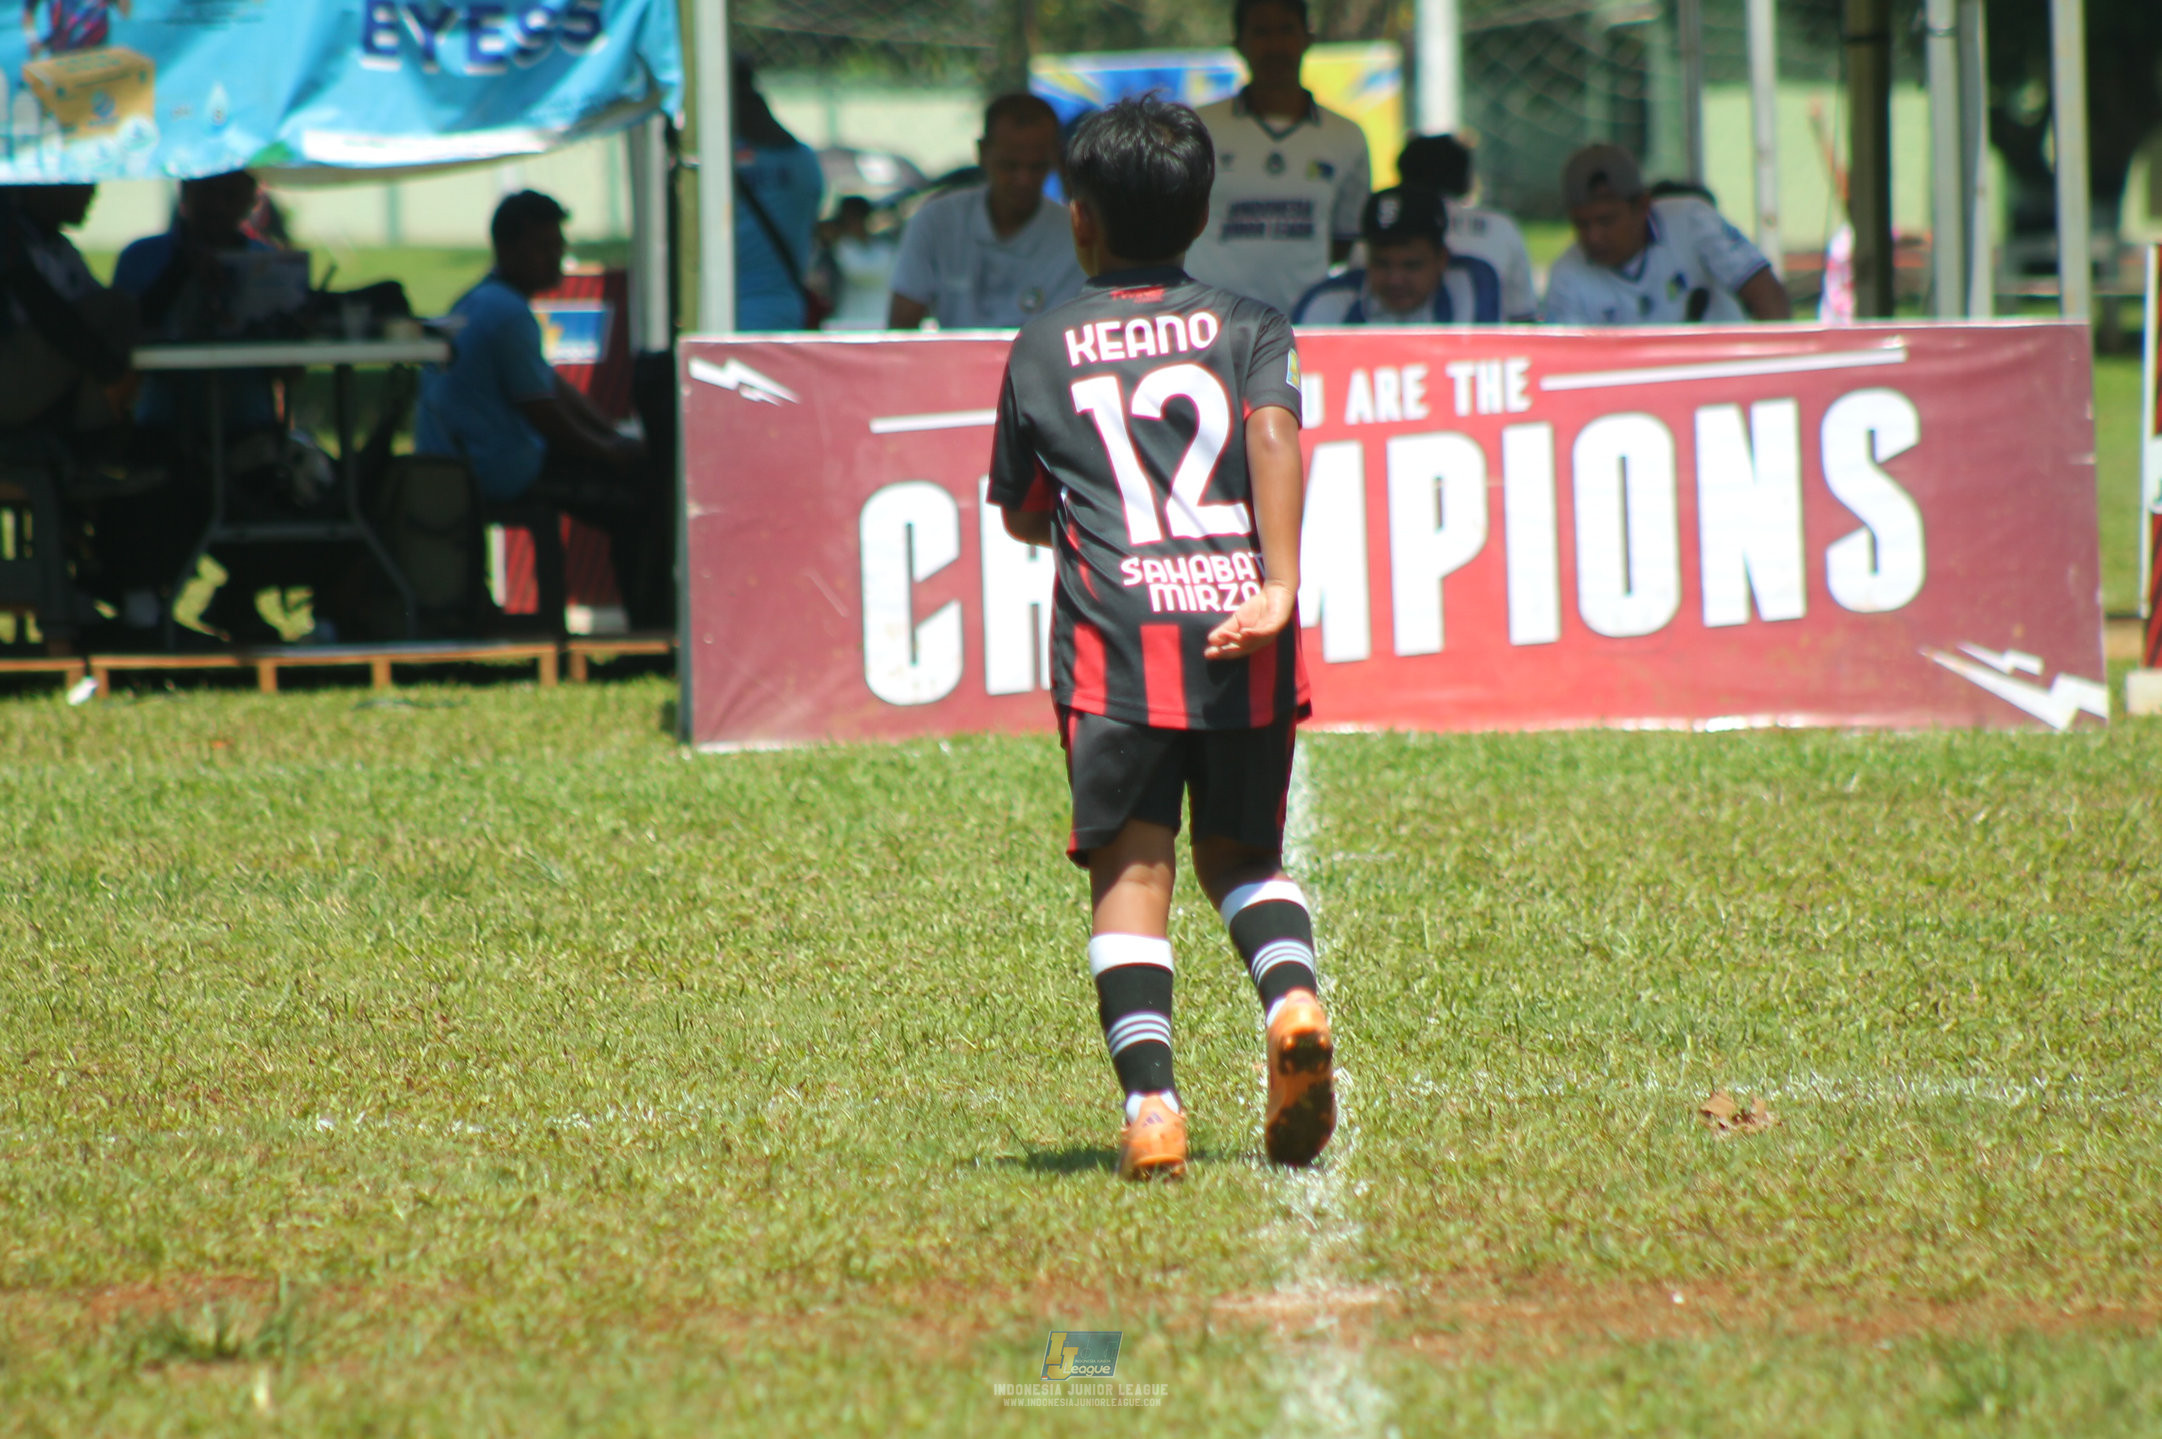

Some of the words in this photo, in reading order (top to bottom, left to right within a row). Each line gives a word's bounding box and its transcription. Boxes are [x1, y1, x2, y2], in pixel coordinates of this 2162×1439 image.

[1064, 311, 1219, 367] KEANO
[1344, 363, 1429, 425] ARE
[1445, 356, 1534, 417] THE
[1070, 362, 1252, 545] 12
[859, 387, 1927, 706] CHMPIONS
